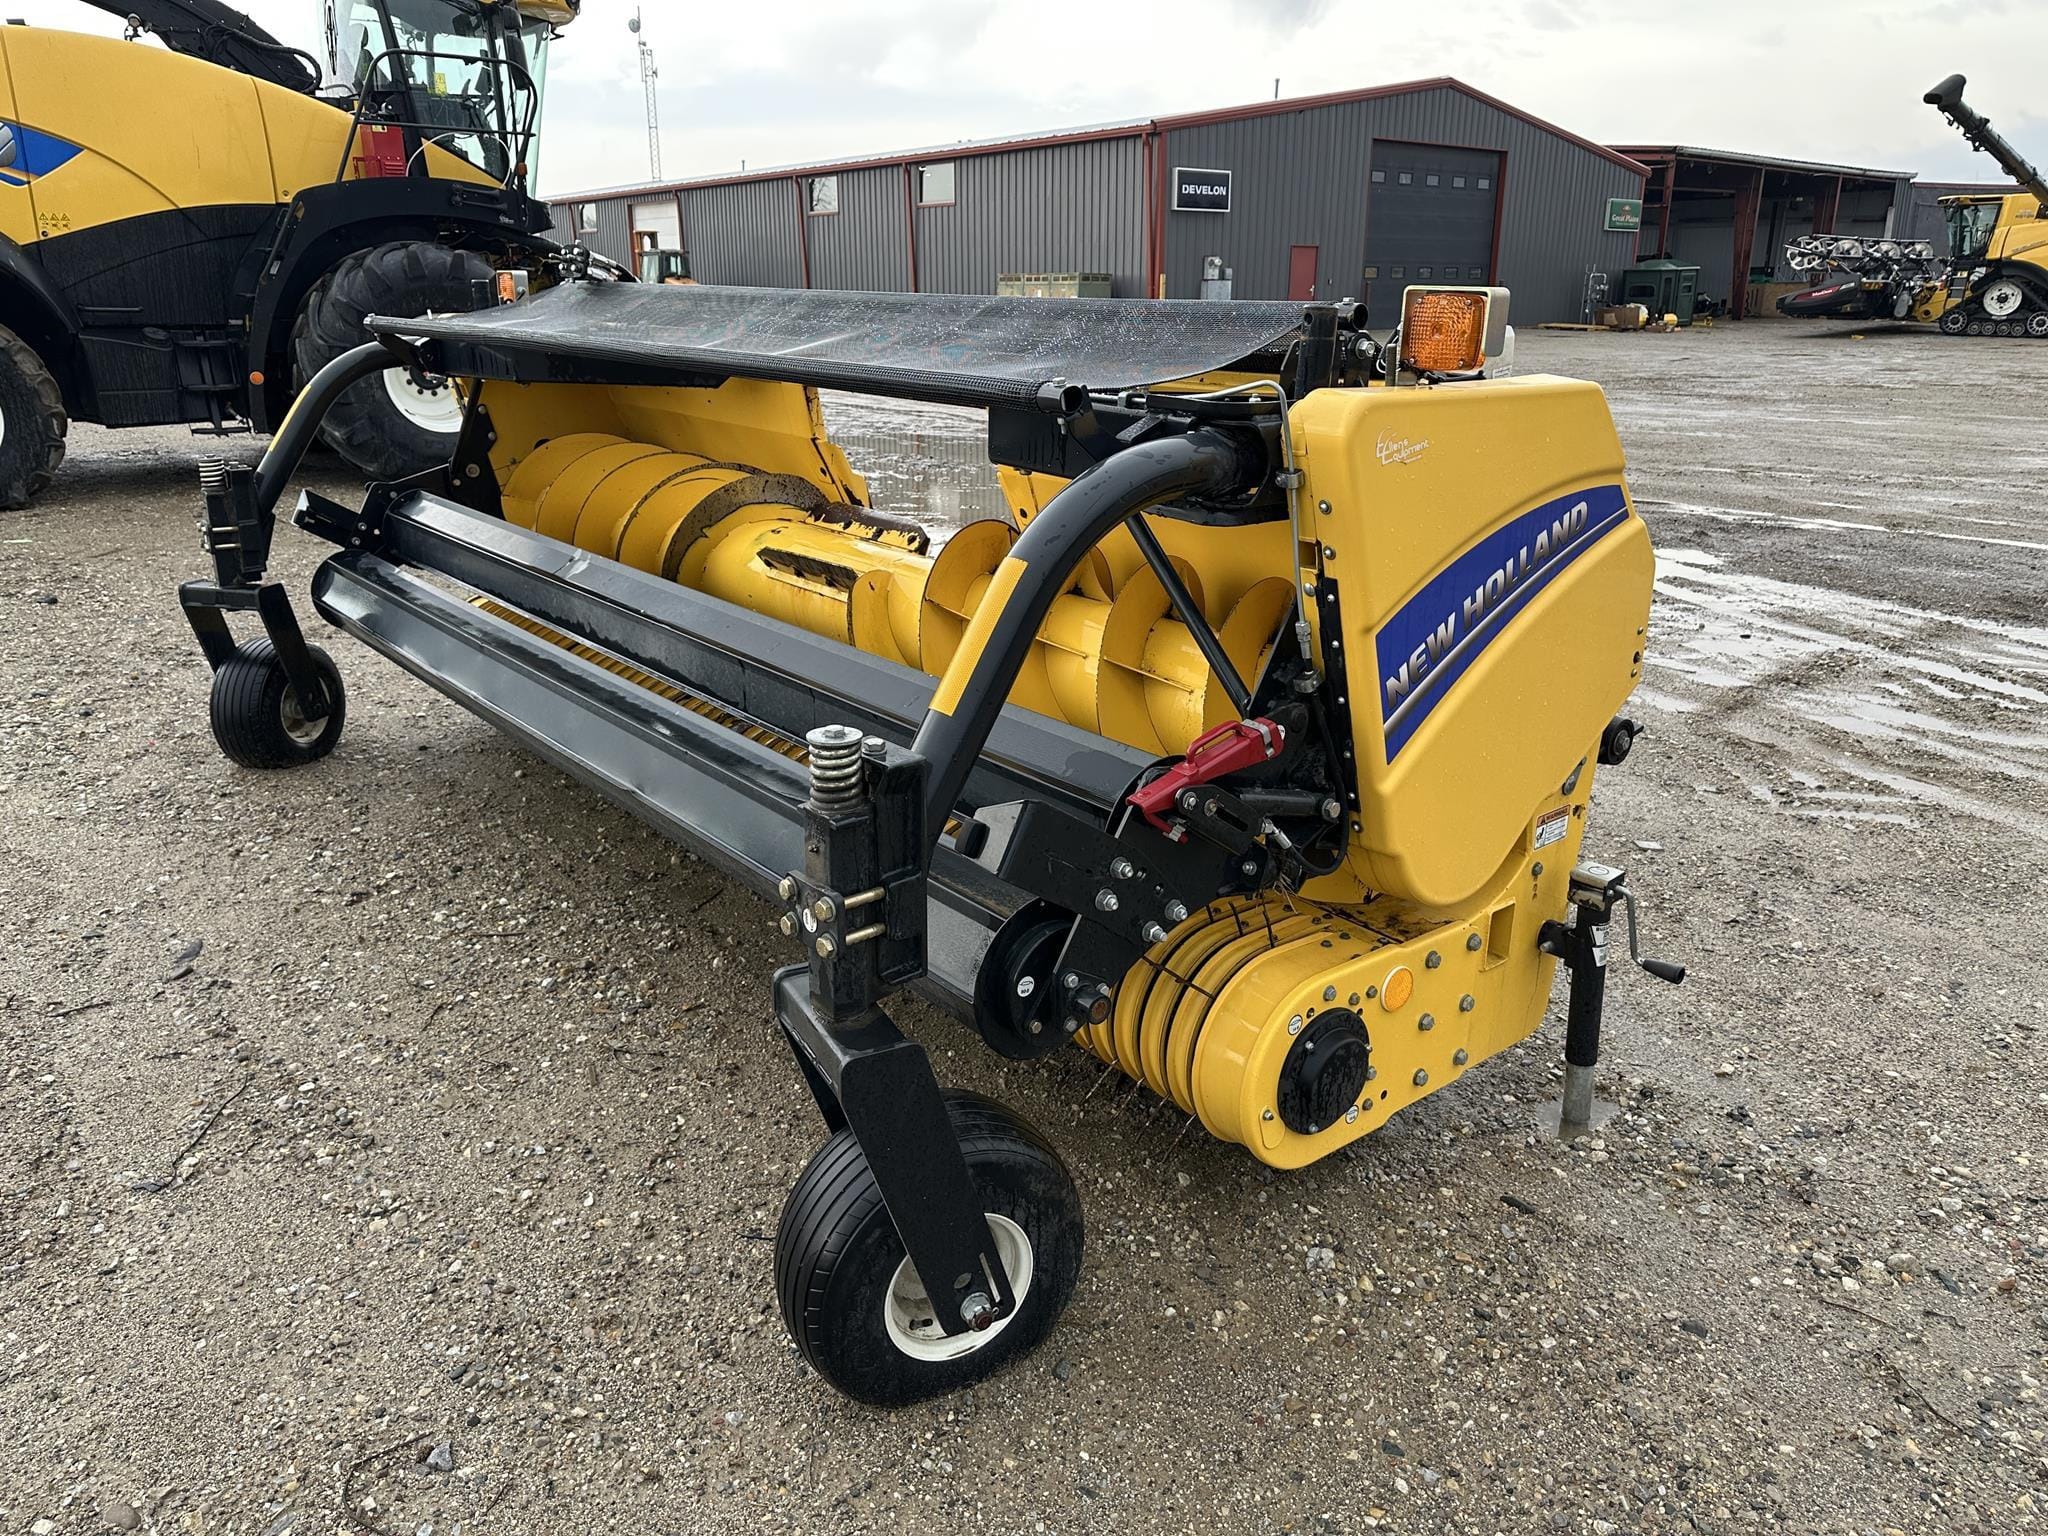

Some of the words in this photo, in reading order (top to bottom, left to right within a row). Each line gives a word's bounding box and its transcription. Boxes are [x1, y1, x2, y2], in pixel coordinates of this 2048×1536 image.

[1182, 184, 1228, 196] DEVELON
[1385, 612, 1456, 711] NEW
[1463, 501, 1589, 632] HOLLAND
